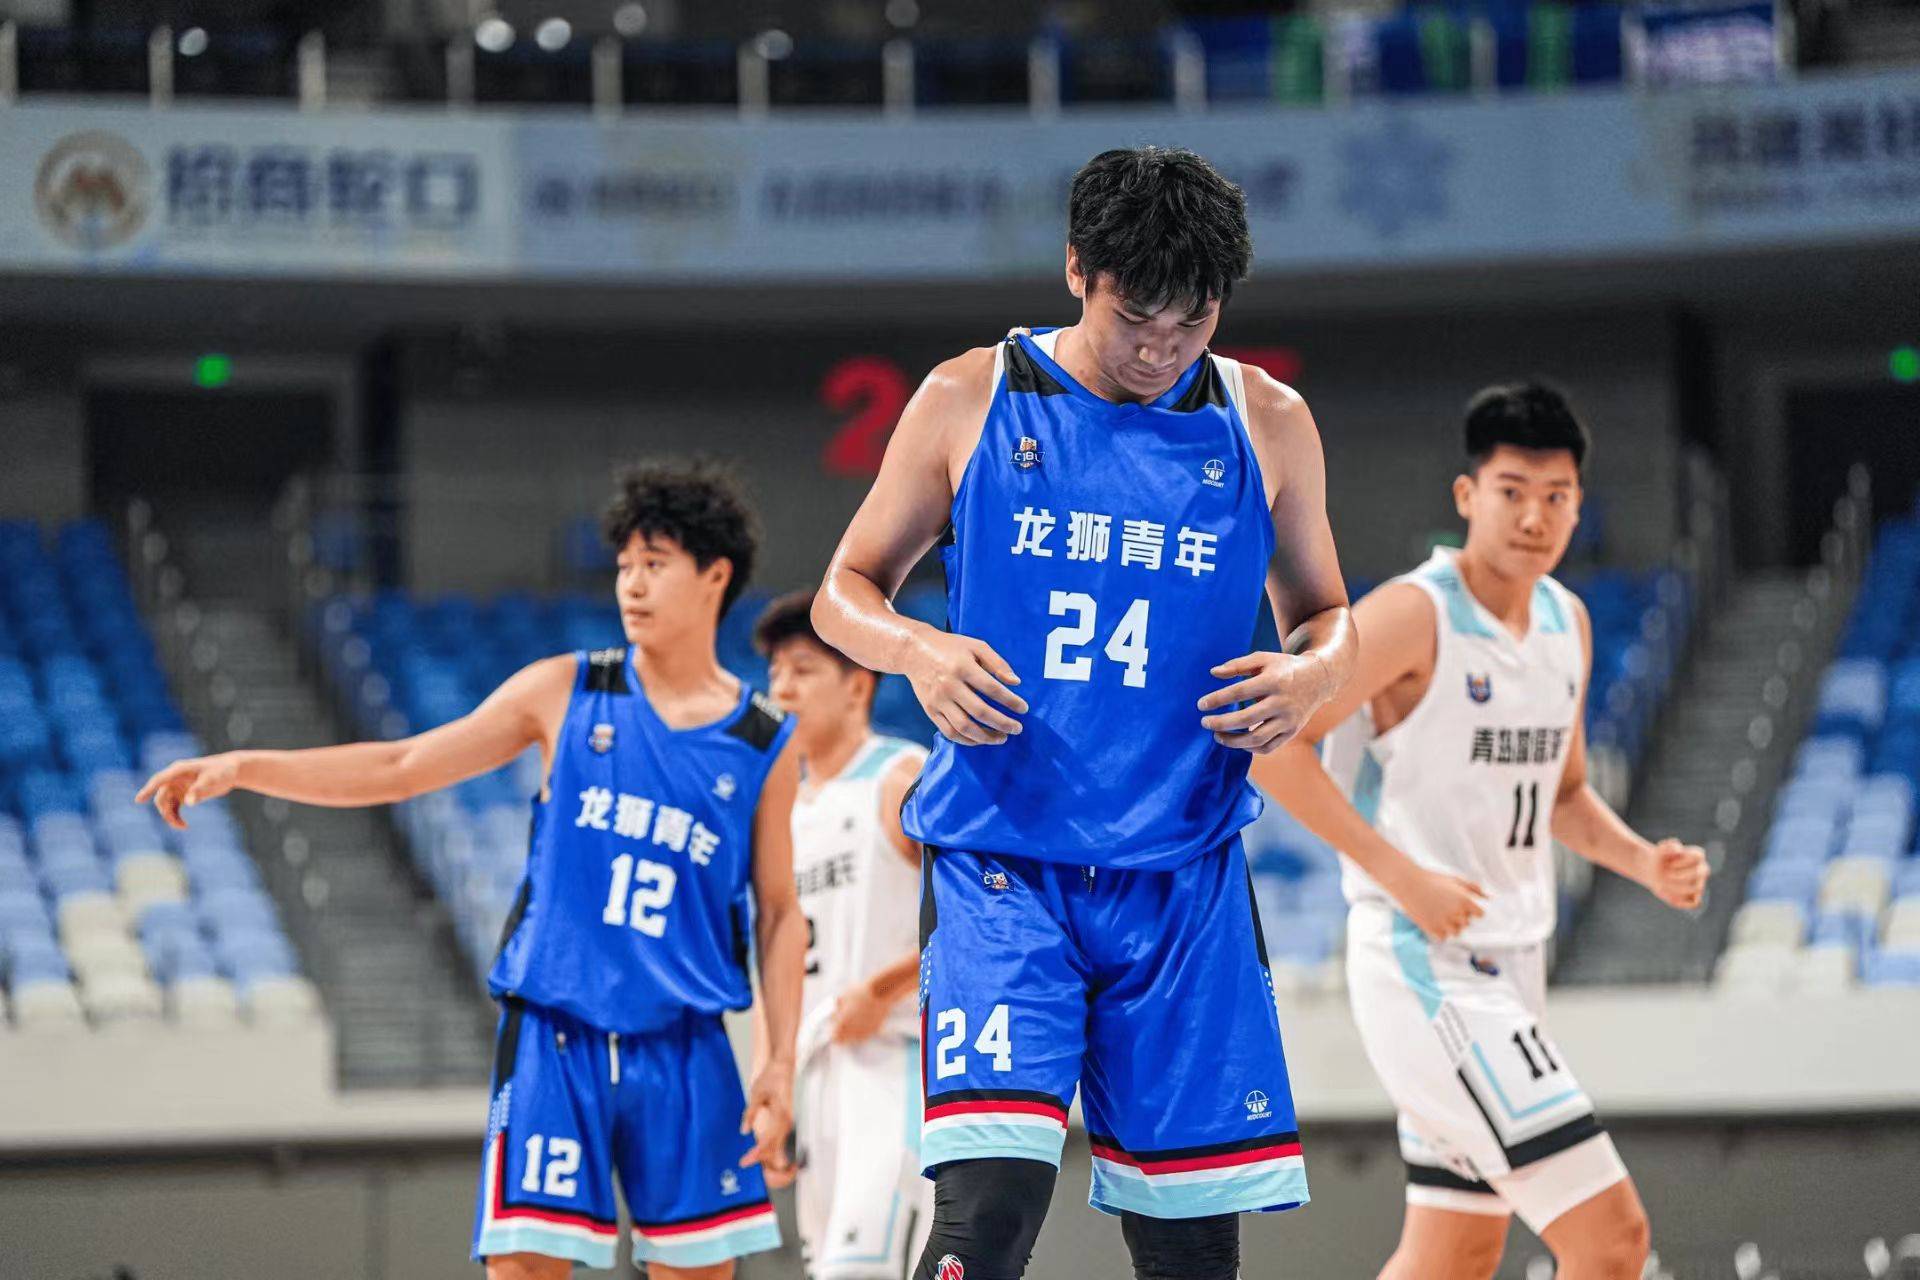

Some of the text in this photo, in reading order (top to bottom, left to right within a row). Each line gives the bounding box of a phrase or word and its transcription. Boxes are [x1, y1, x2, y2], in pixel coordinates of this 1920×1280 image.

[1010, 506, 1218, 577] 龙狮青年
[1043, 590, 1150, 688] 24
[575, 786, 721, 867] 龙狮青年
[1506, 780, 1540, 848] 11
[602, 853, 677, 938] 12
[936, 1004, 1012, 1080] 24
[1513, 1024, 1558, 1079] 11
[521, 1134, 581, 1197] 12
